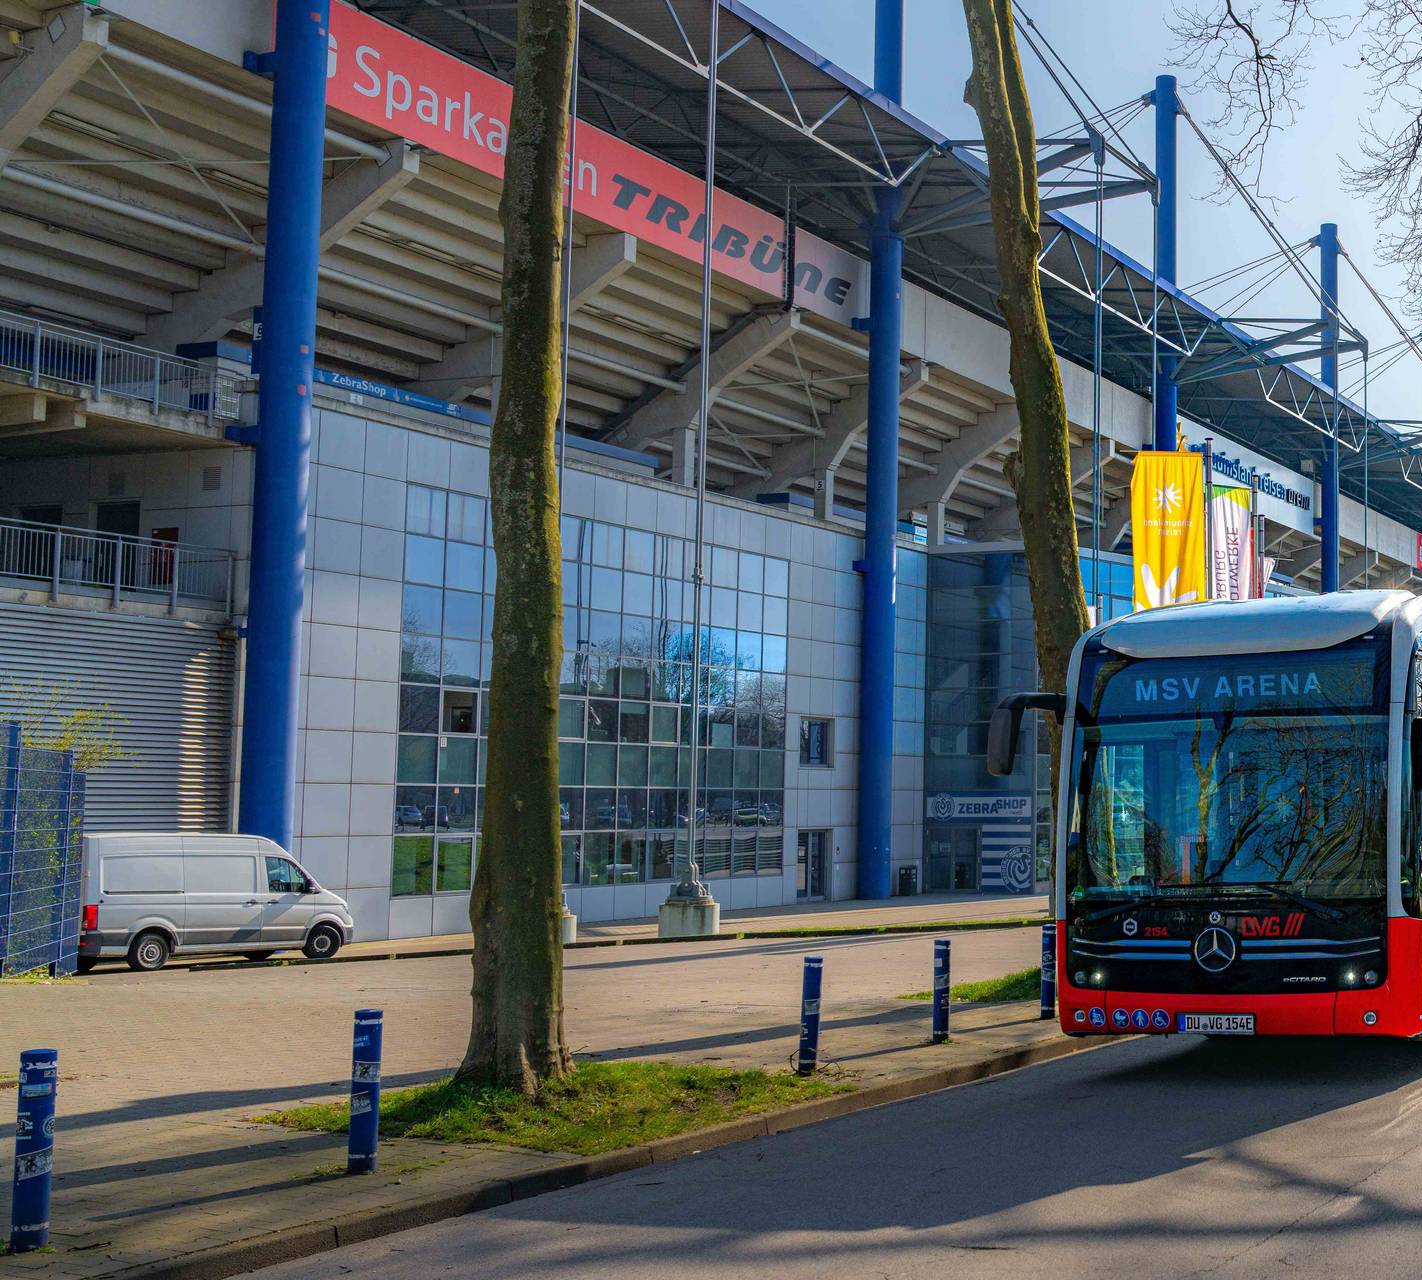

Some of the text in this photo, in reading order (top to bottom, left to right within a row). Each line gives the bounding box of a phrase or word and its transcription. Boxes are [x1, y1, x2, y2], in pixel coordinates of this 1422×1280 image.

[353, 45, 598, 197] Sparkan
[332, 372, 387, 397] ZebraShop
[1135, 672, 1321, 701] MSV ARENA
[1144, 927, 1168, 937] 2154
[1241, 916, 1281, 937] DVG
[1186, 1014, 1252, 1031] DU VG 154E
